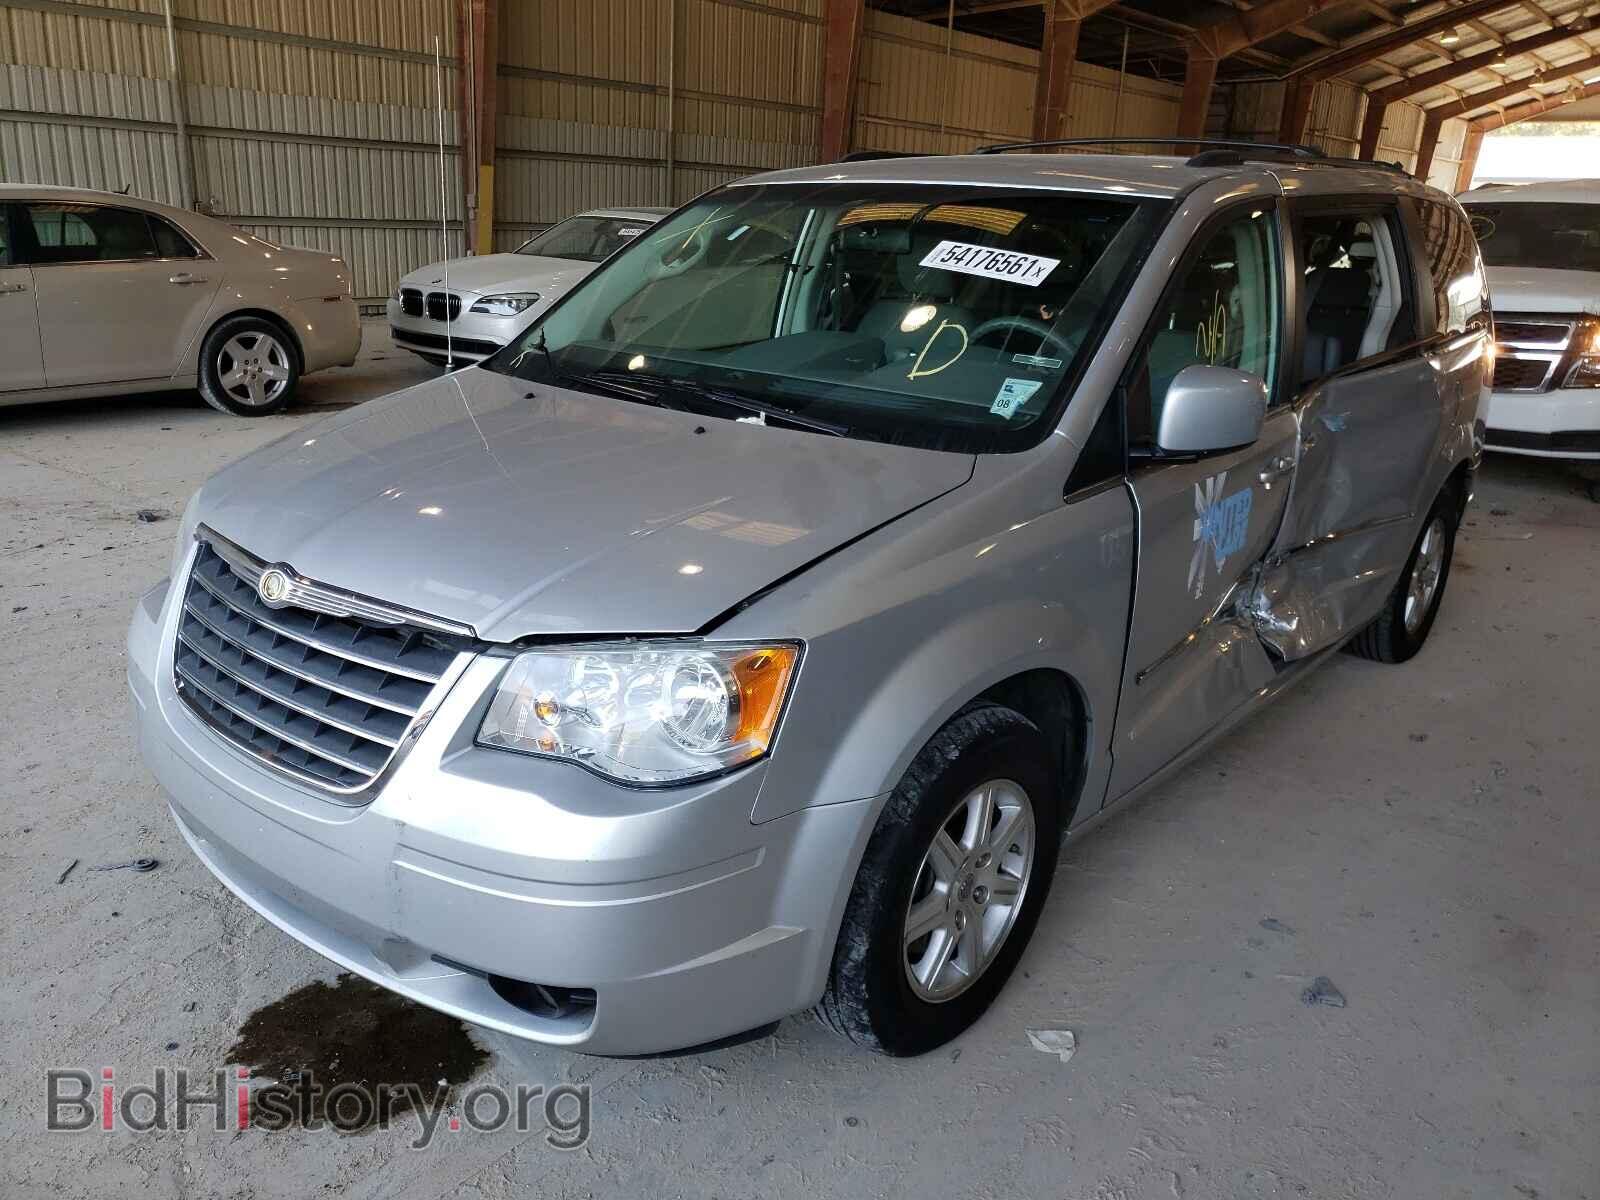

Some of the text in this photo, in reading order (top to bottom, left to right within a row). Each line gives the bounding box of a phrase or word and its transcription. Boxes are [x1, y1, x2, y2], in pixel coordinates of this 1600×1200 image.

[940, 245, 1039, 277] 54176561
[906, 319, 969, 381] D
[996, 399, 1010, 409] 08
